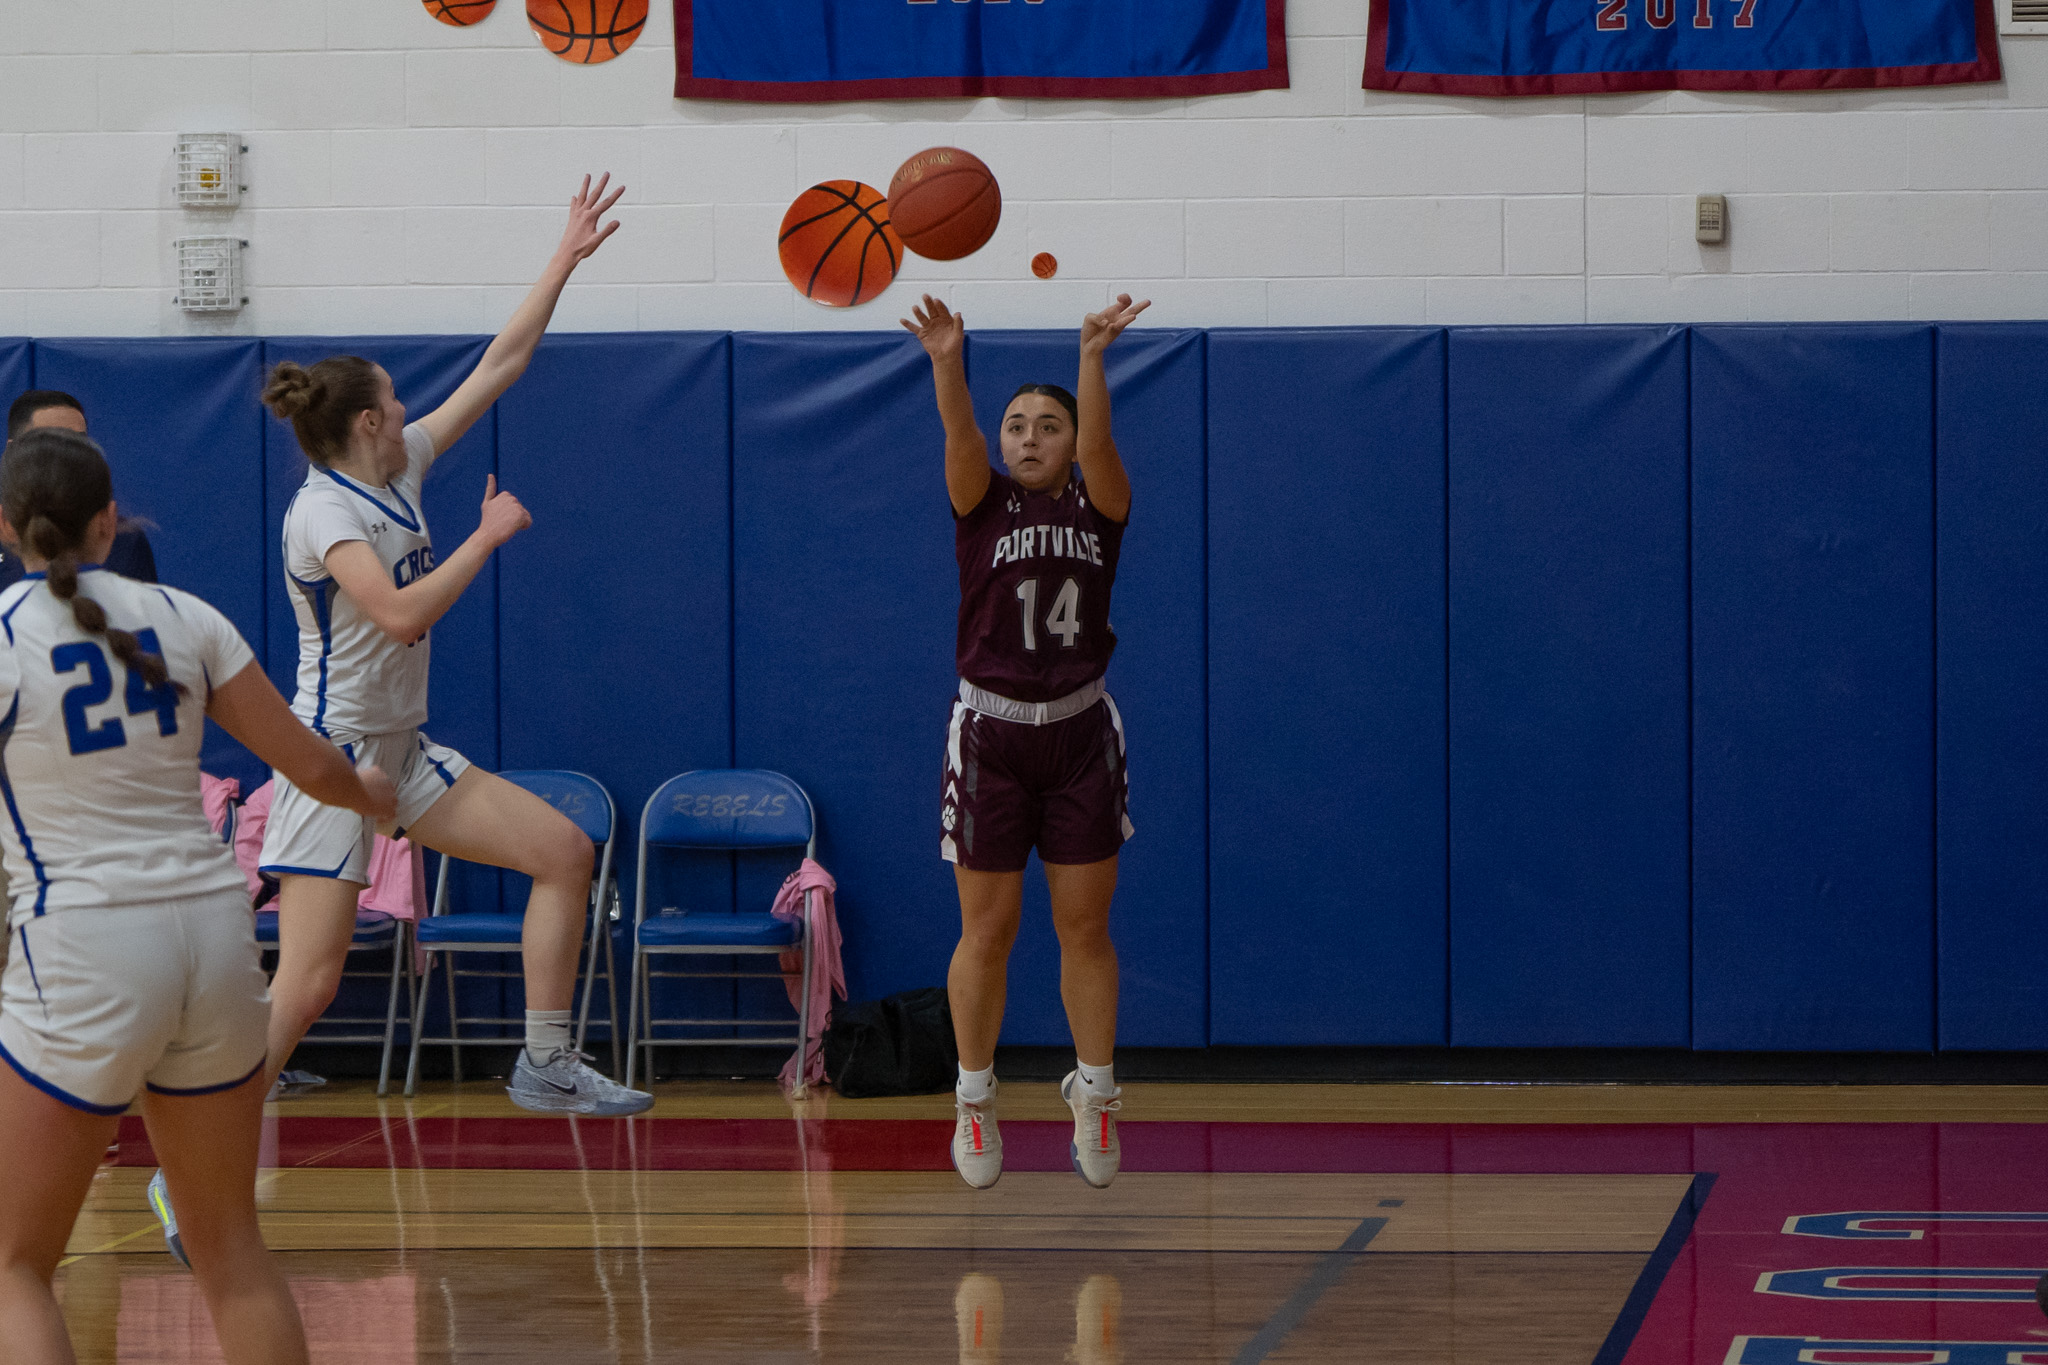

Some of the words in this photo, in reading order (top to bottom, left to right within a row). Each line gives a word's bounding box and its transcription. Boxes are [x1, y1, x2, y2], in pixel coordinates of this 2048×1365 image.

[1596, 0, 1758, 31] 2017
[1015, 577, 1081, 651] 14
[50, 627, 181, 756] 24
[673, 794, 788, 817] REBELS
